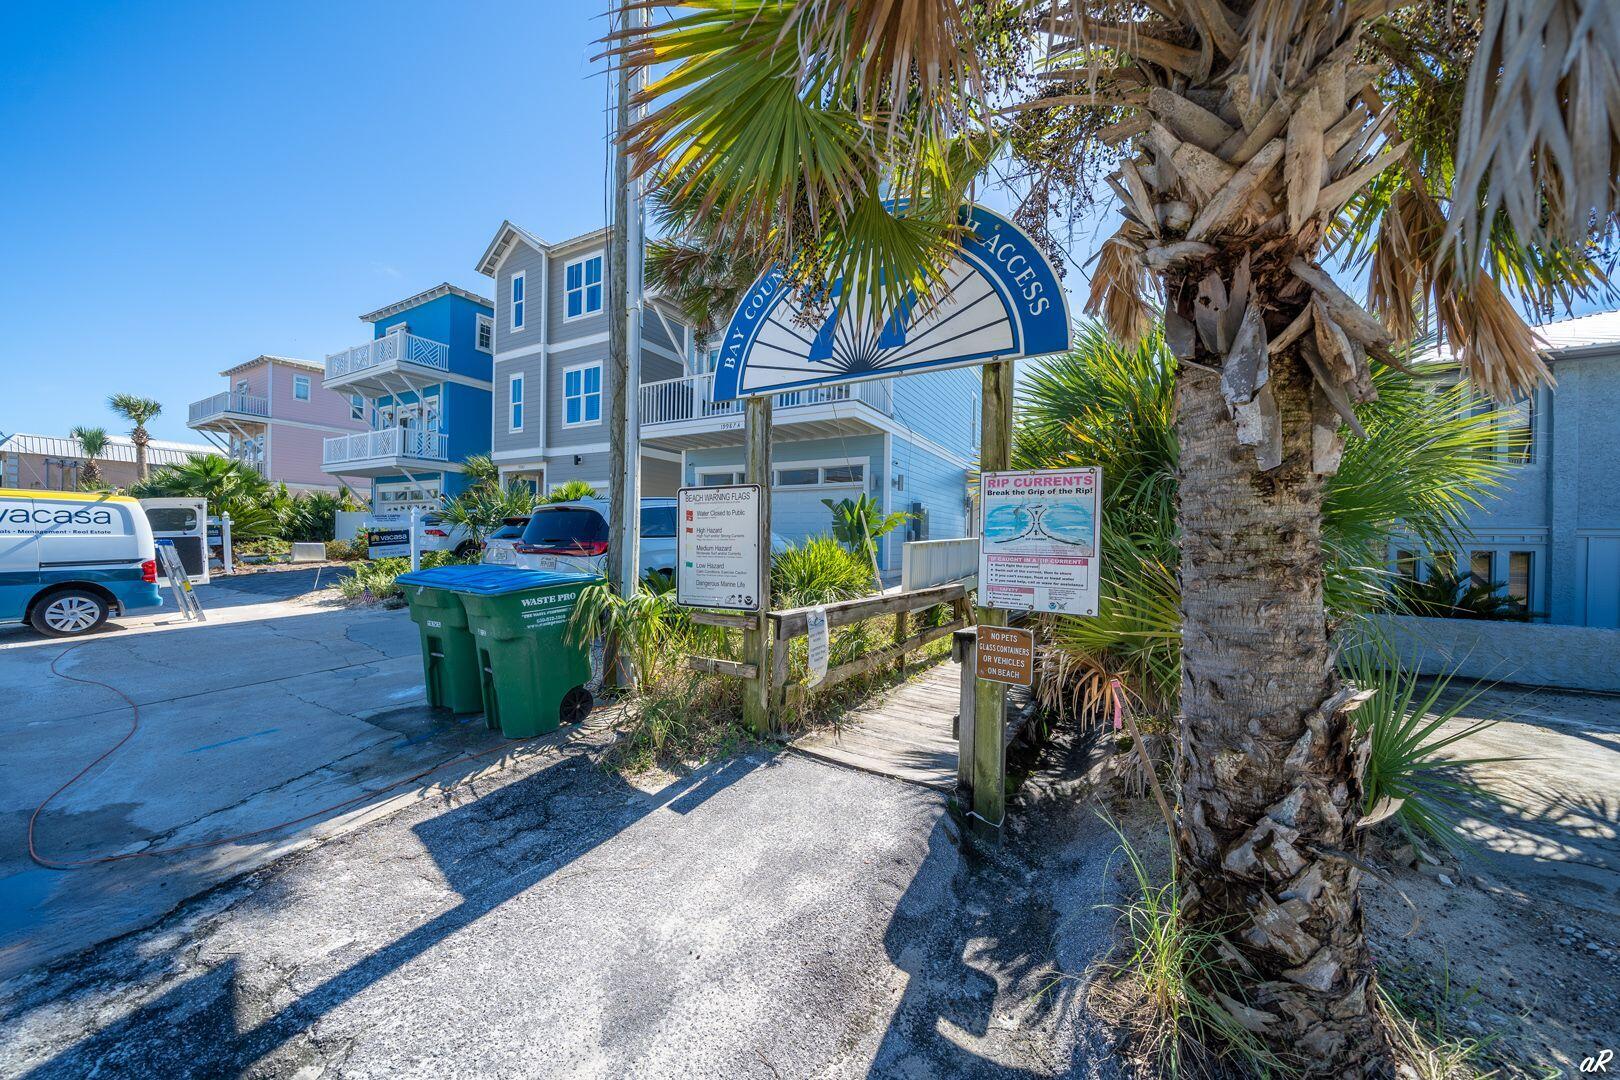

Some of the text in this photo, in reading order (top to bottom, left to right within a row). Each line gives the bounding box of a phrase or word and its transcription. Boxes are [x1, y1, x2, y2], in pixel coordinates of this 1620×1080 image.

[979, 234, 1050, 316] ACCESS
[724, 268, 784, 369] BAY COUN
[988, 476, 1093, 488] RIP CURRENTS
[686, 492, 750, 502] BEACH WARNING FLAGS
[521, 592, 576, 607] WASTE PRO
[1002, 634, 1018, 642] PETS
[979, 643, 1030, 656] GLASS CONTAINERS
[994, 657, 1025, 668] VEHICLES
[998, 669, 1020, 678] BEACH
